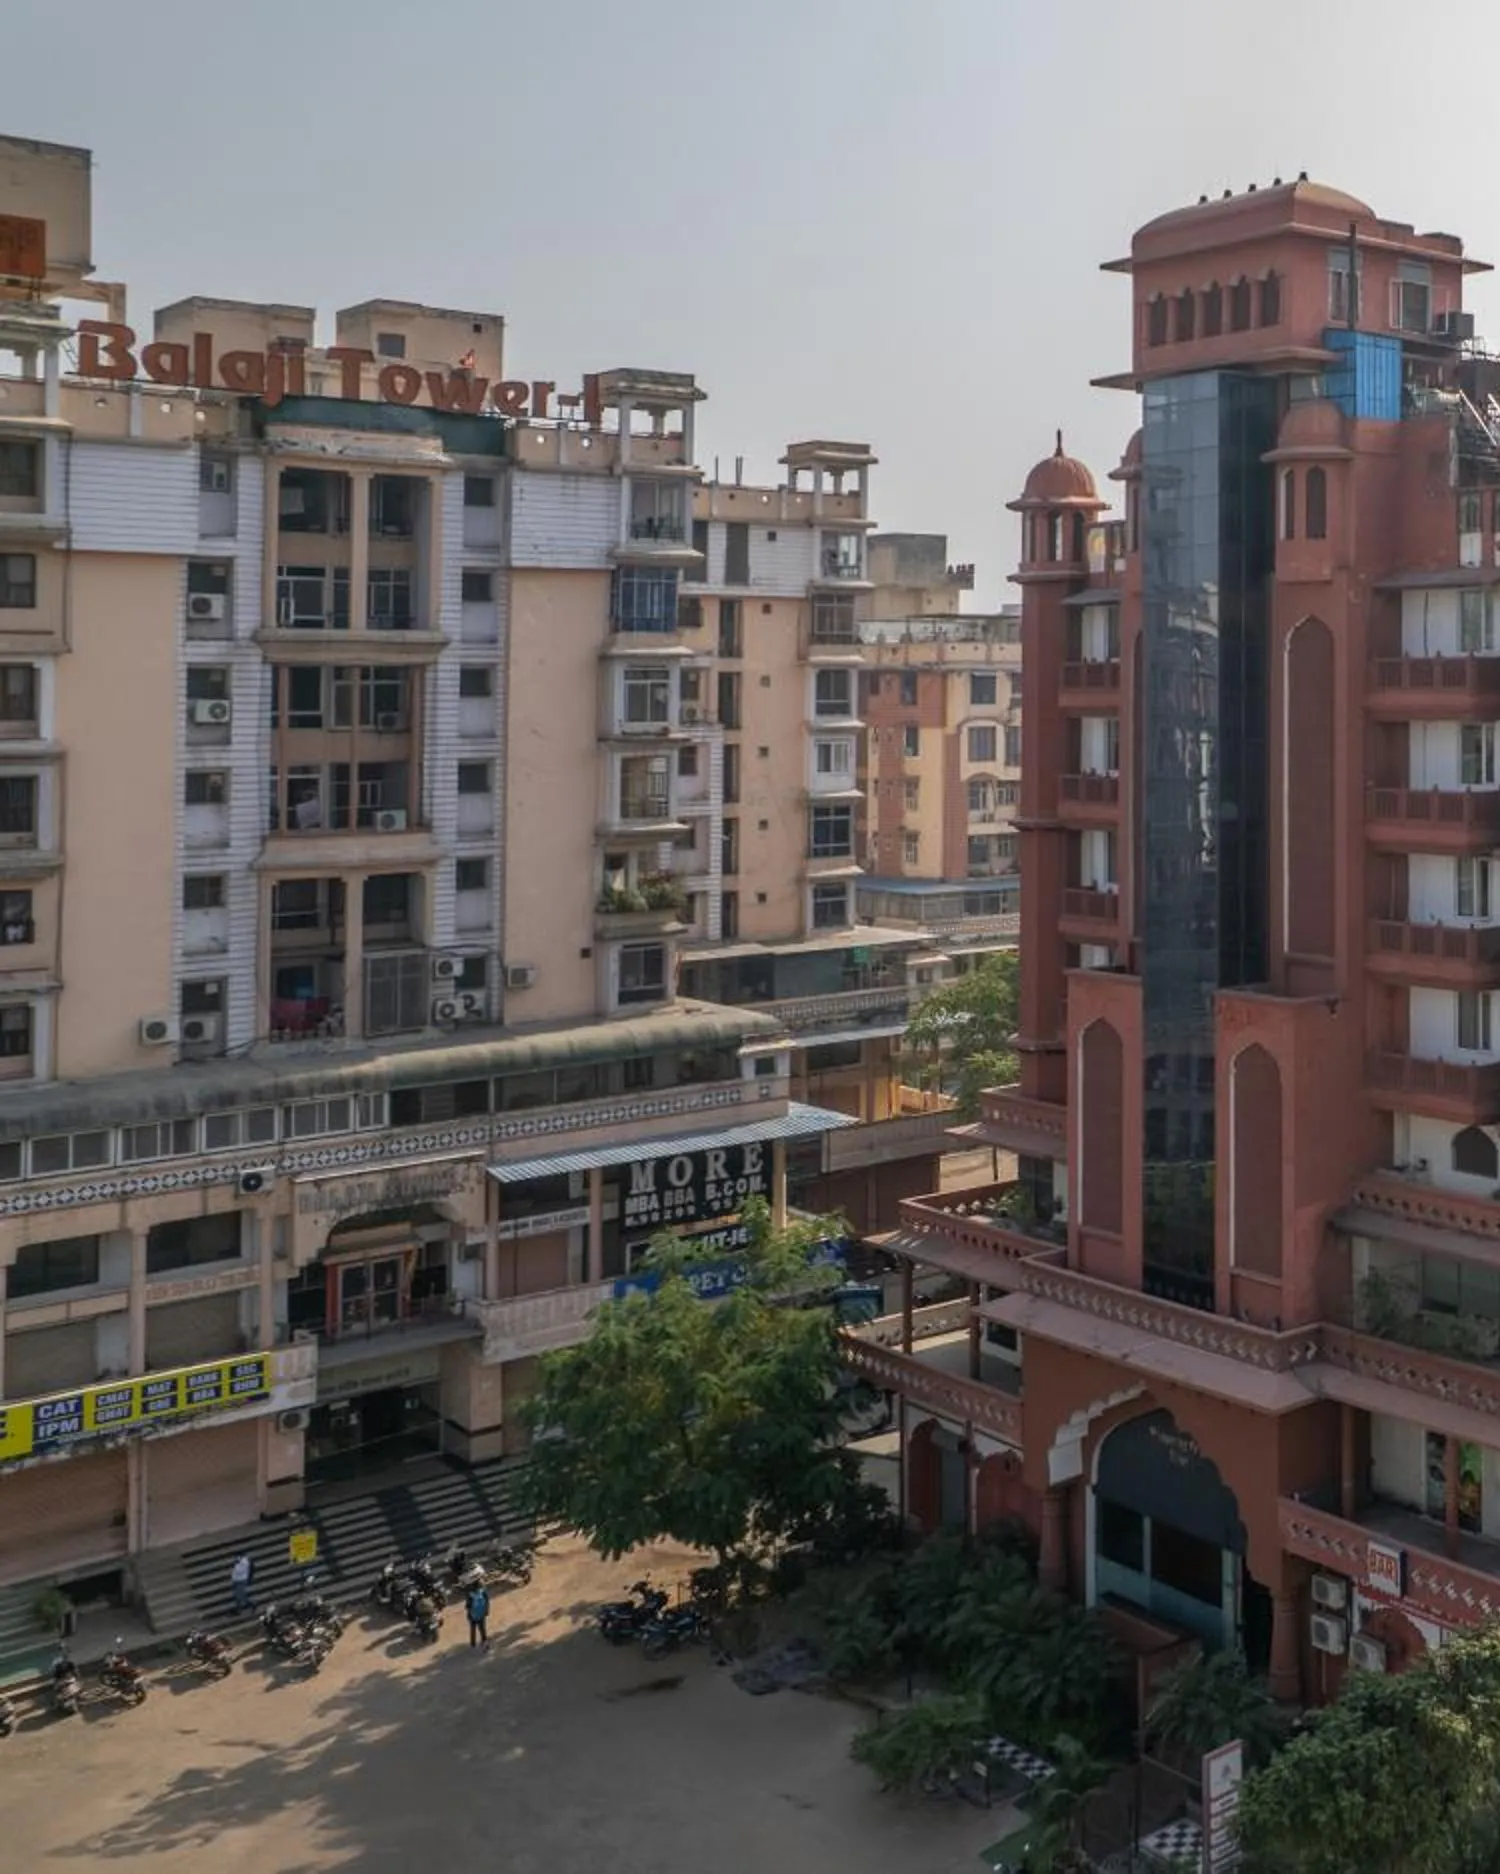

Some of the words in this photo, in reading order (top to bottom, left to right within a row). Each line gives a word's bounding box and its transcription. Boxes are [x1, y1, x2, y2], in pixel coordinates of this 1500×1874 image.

[77, 320, 305, 408] Balaji
[630, 1144, 763, 1194] MORE
[625, 1193, 660, 1216] MBA
[147, 1381, 173, 1396] MAT
[38, 1399, 81, 1420] CAT
[38, 1418, 80, 1439] IPM
